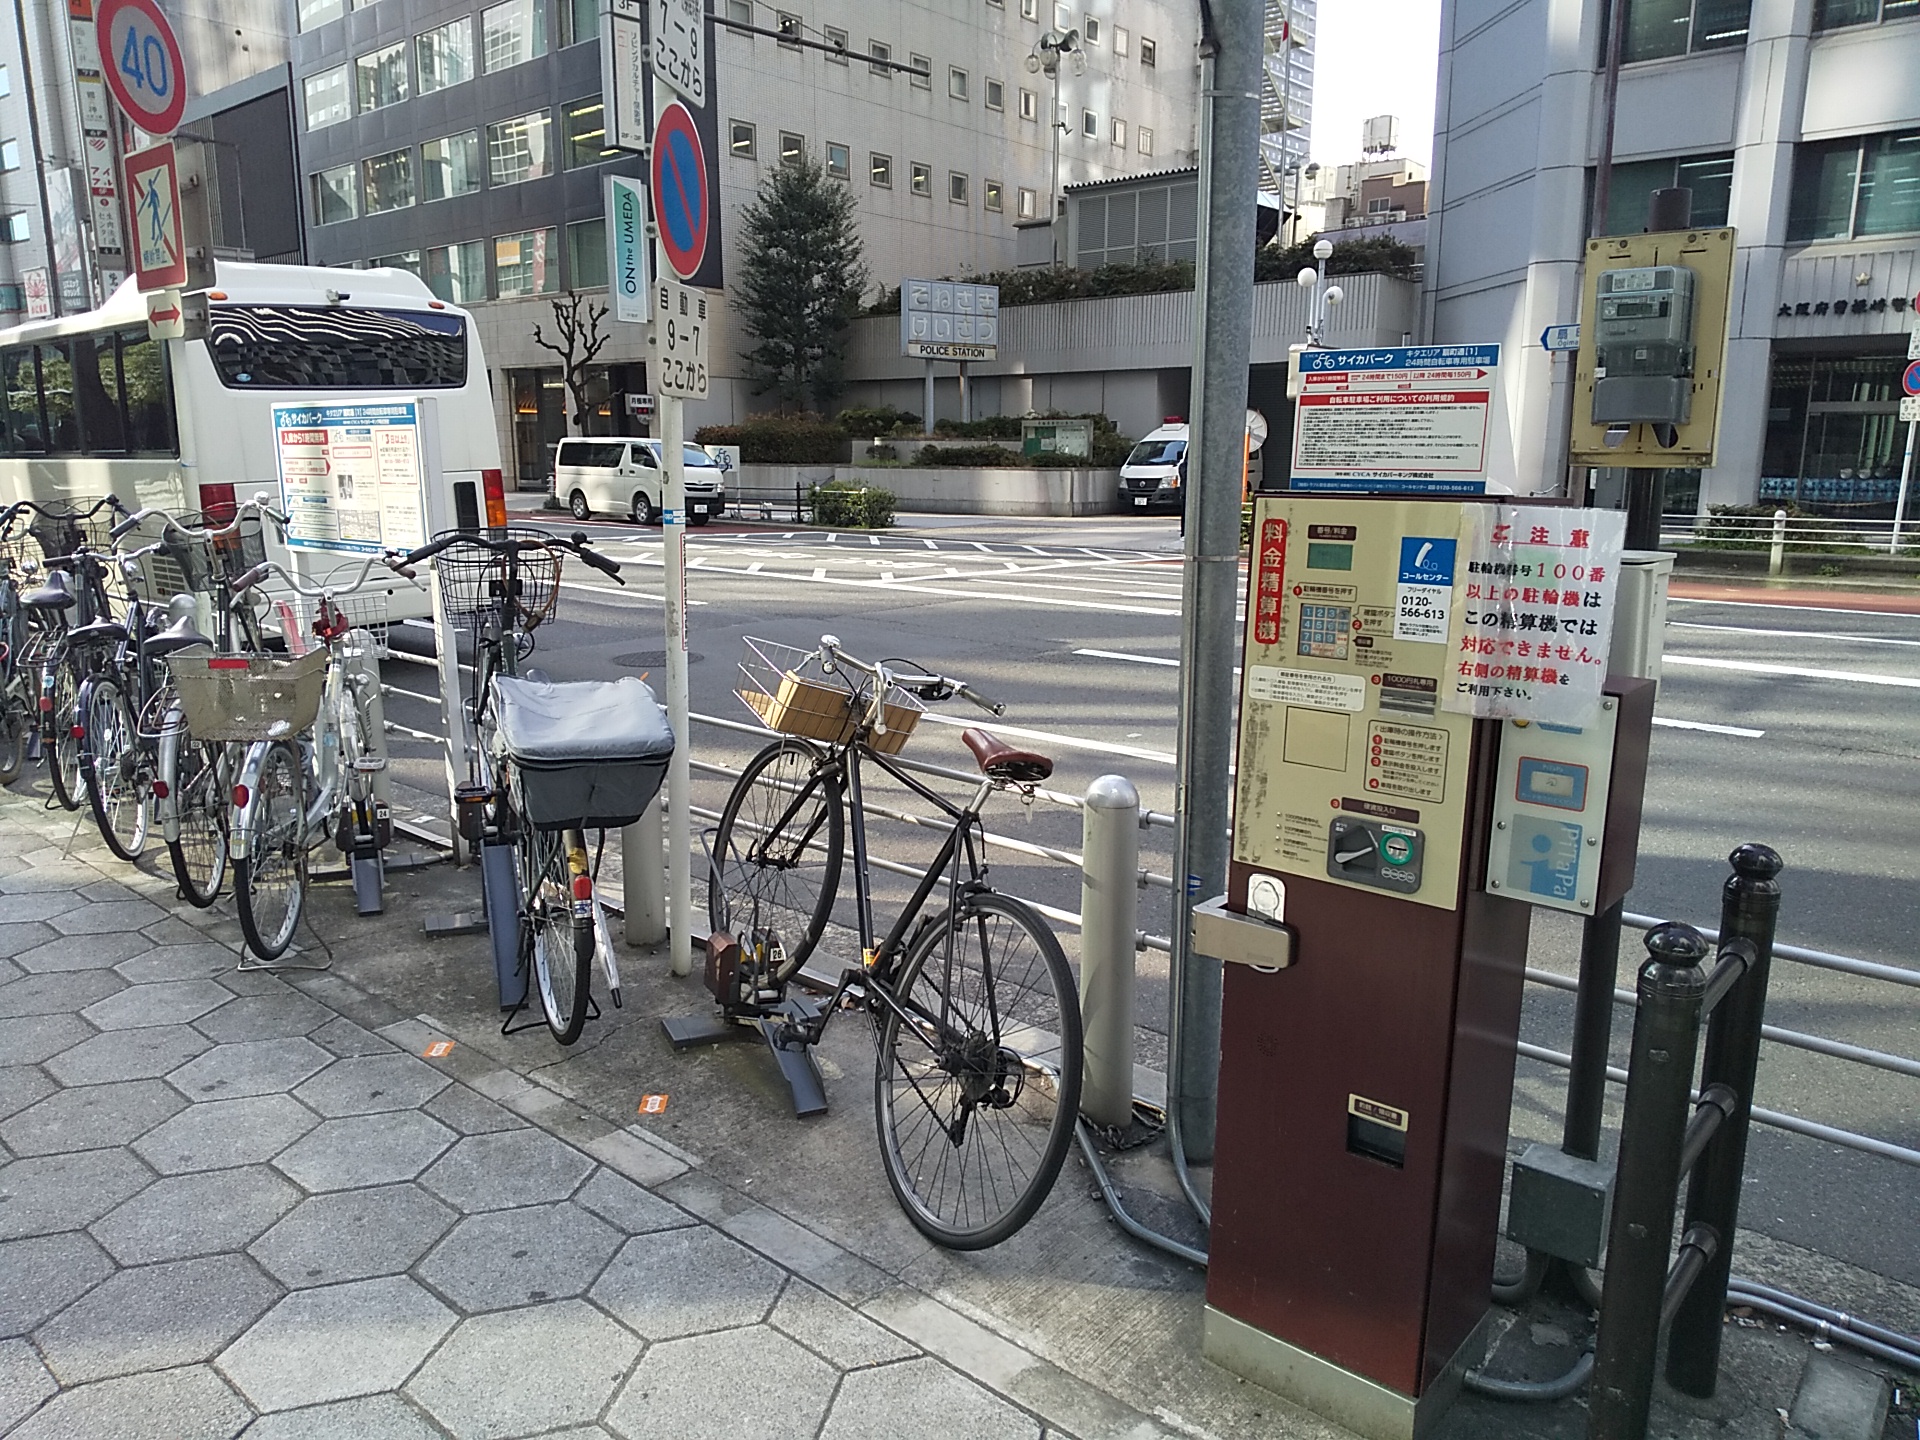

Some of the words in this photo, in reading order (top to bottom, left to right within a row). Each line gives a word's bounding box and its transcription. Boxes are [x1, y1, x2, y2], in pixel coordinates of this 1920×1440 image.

[618, 0, 633, 10] 3F
[122, 26, 168, 98] 40
[656, 37, 703, 97] ここから
[622, 192, 635, 244] UMEDA
[625, 267, 637, 294] ON
[911, 285, 995, 312] そねざき
[912, 316, 994, 340] けいさつ
[920, 345, 949, 356] POLICE
[952, 347, 985, 358] STATION
[1406, 349, 1441, 358] キタエリア
[1338, 353, 1394, 366] サイカパーク
[1405, 356, 1491, 367] 24時間自転車専用駐車場
[662, 357, 707, 393] ここから
[1329, 394, 1455, 405] 自転車駐車場ご利用についての利用規約
[291, 412, 322, 425] サイカパーク
[1257, 522, 1284, 640] 料金精算機
[1402, 572, 1450, 581] コールセンター
[1407, 586, 1442, 595] フリーダイヤル
[1466, 583, 1602, 608] 以上の駐輪機は
[1401, 595, 1432, 607] 0120-
[1317, 608, 1324, 617] 2
[1328, 609, 1335, 618] 3
[1400, 607, 1445, 620] 566-613
[1304, 620, 1311, 628] 4
[1316, 622, 1323, 631] 5
[1465, 610, 1598, 636] この精算機では
[1303, 632, 1310, 640] 7
[1315, 633, 1322, 642] 8
[1302, 644, 1309, 653] 0
[1460, 635, 1603, 665] 対応できません。
[1457, 660, 1570, 686] 右側の精算機を
[1386, 675, 1434, 687] 1000円札専用
[1456, 682, 1532, 700] ご利用下さい。
[378, 810, 387, 818] 24
[1553, 825, 1580, 897] PiTaPa
[772, 949, 783, 960] 26
